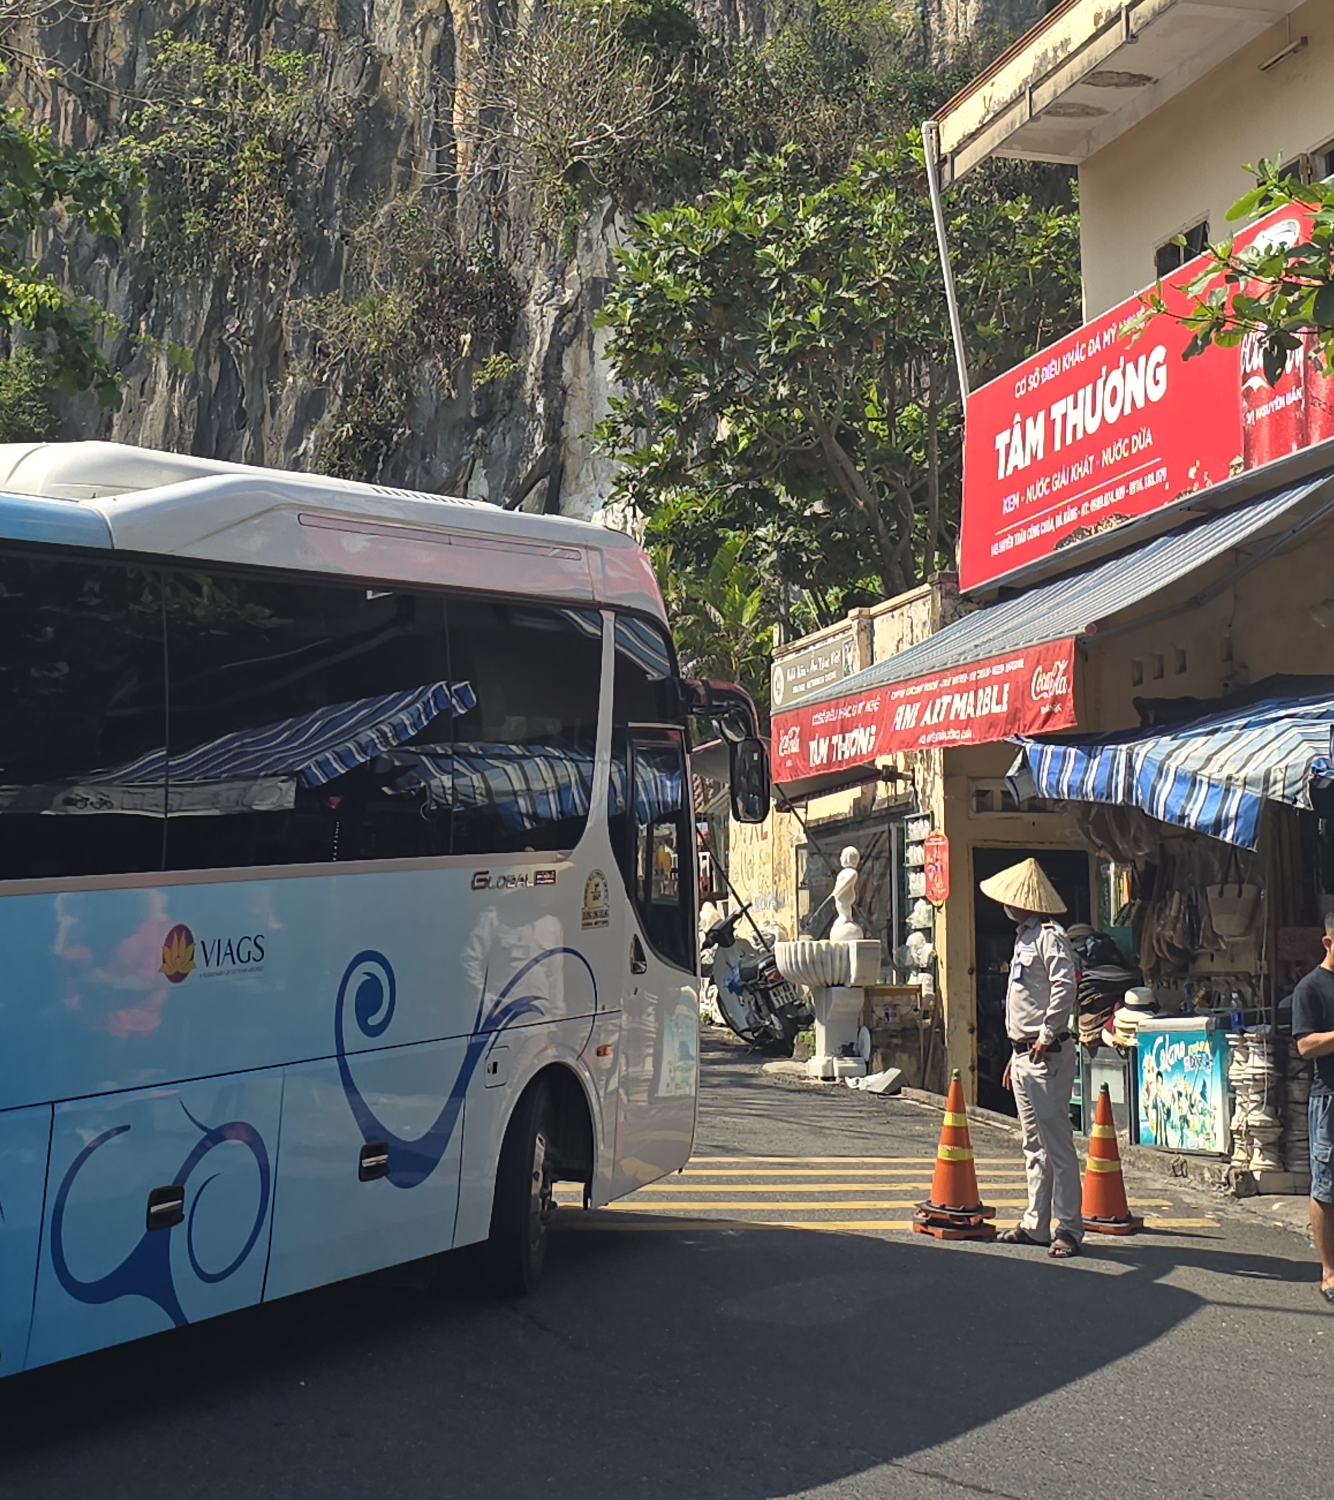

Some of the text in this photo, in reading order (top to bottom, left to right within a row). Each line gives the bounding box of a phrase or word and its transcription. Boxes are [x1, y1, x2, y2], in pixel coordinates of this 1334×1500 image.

[994, 412, 1045, 481] TÂM
[1050, 344, 1167, 452] THƯƠNG
[201, 934, 265, 968] VIAGS
